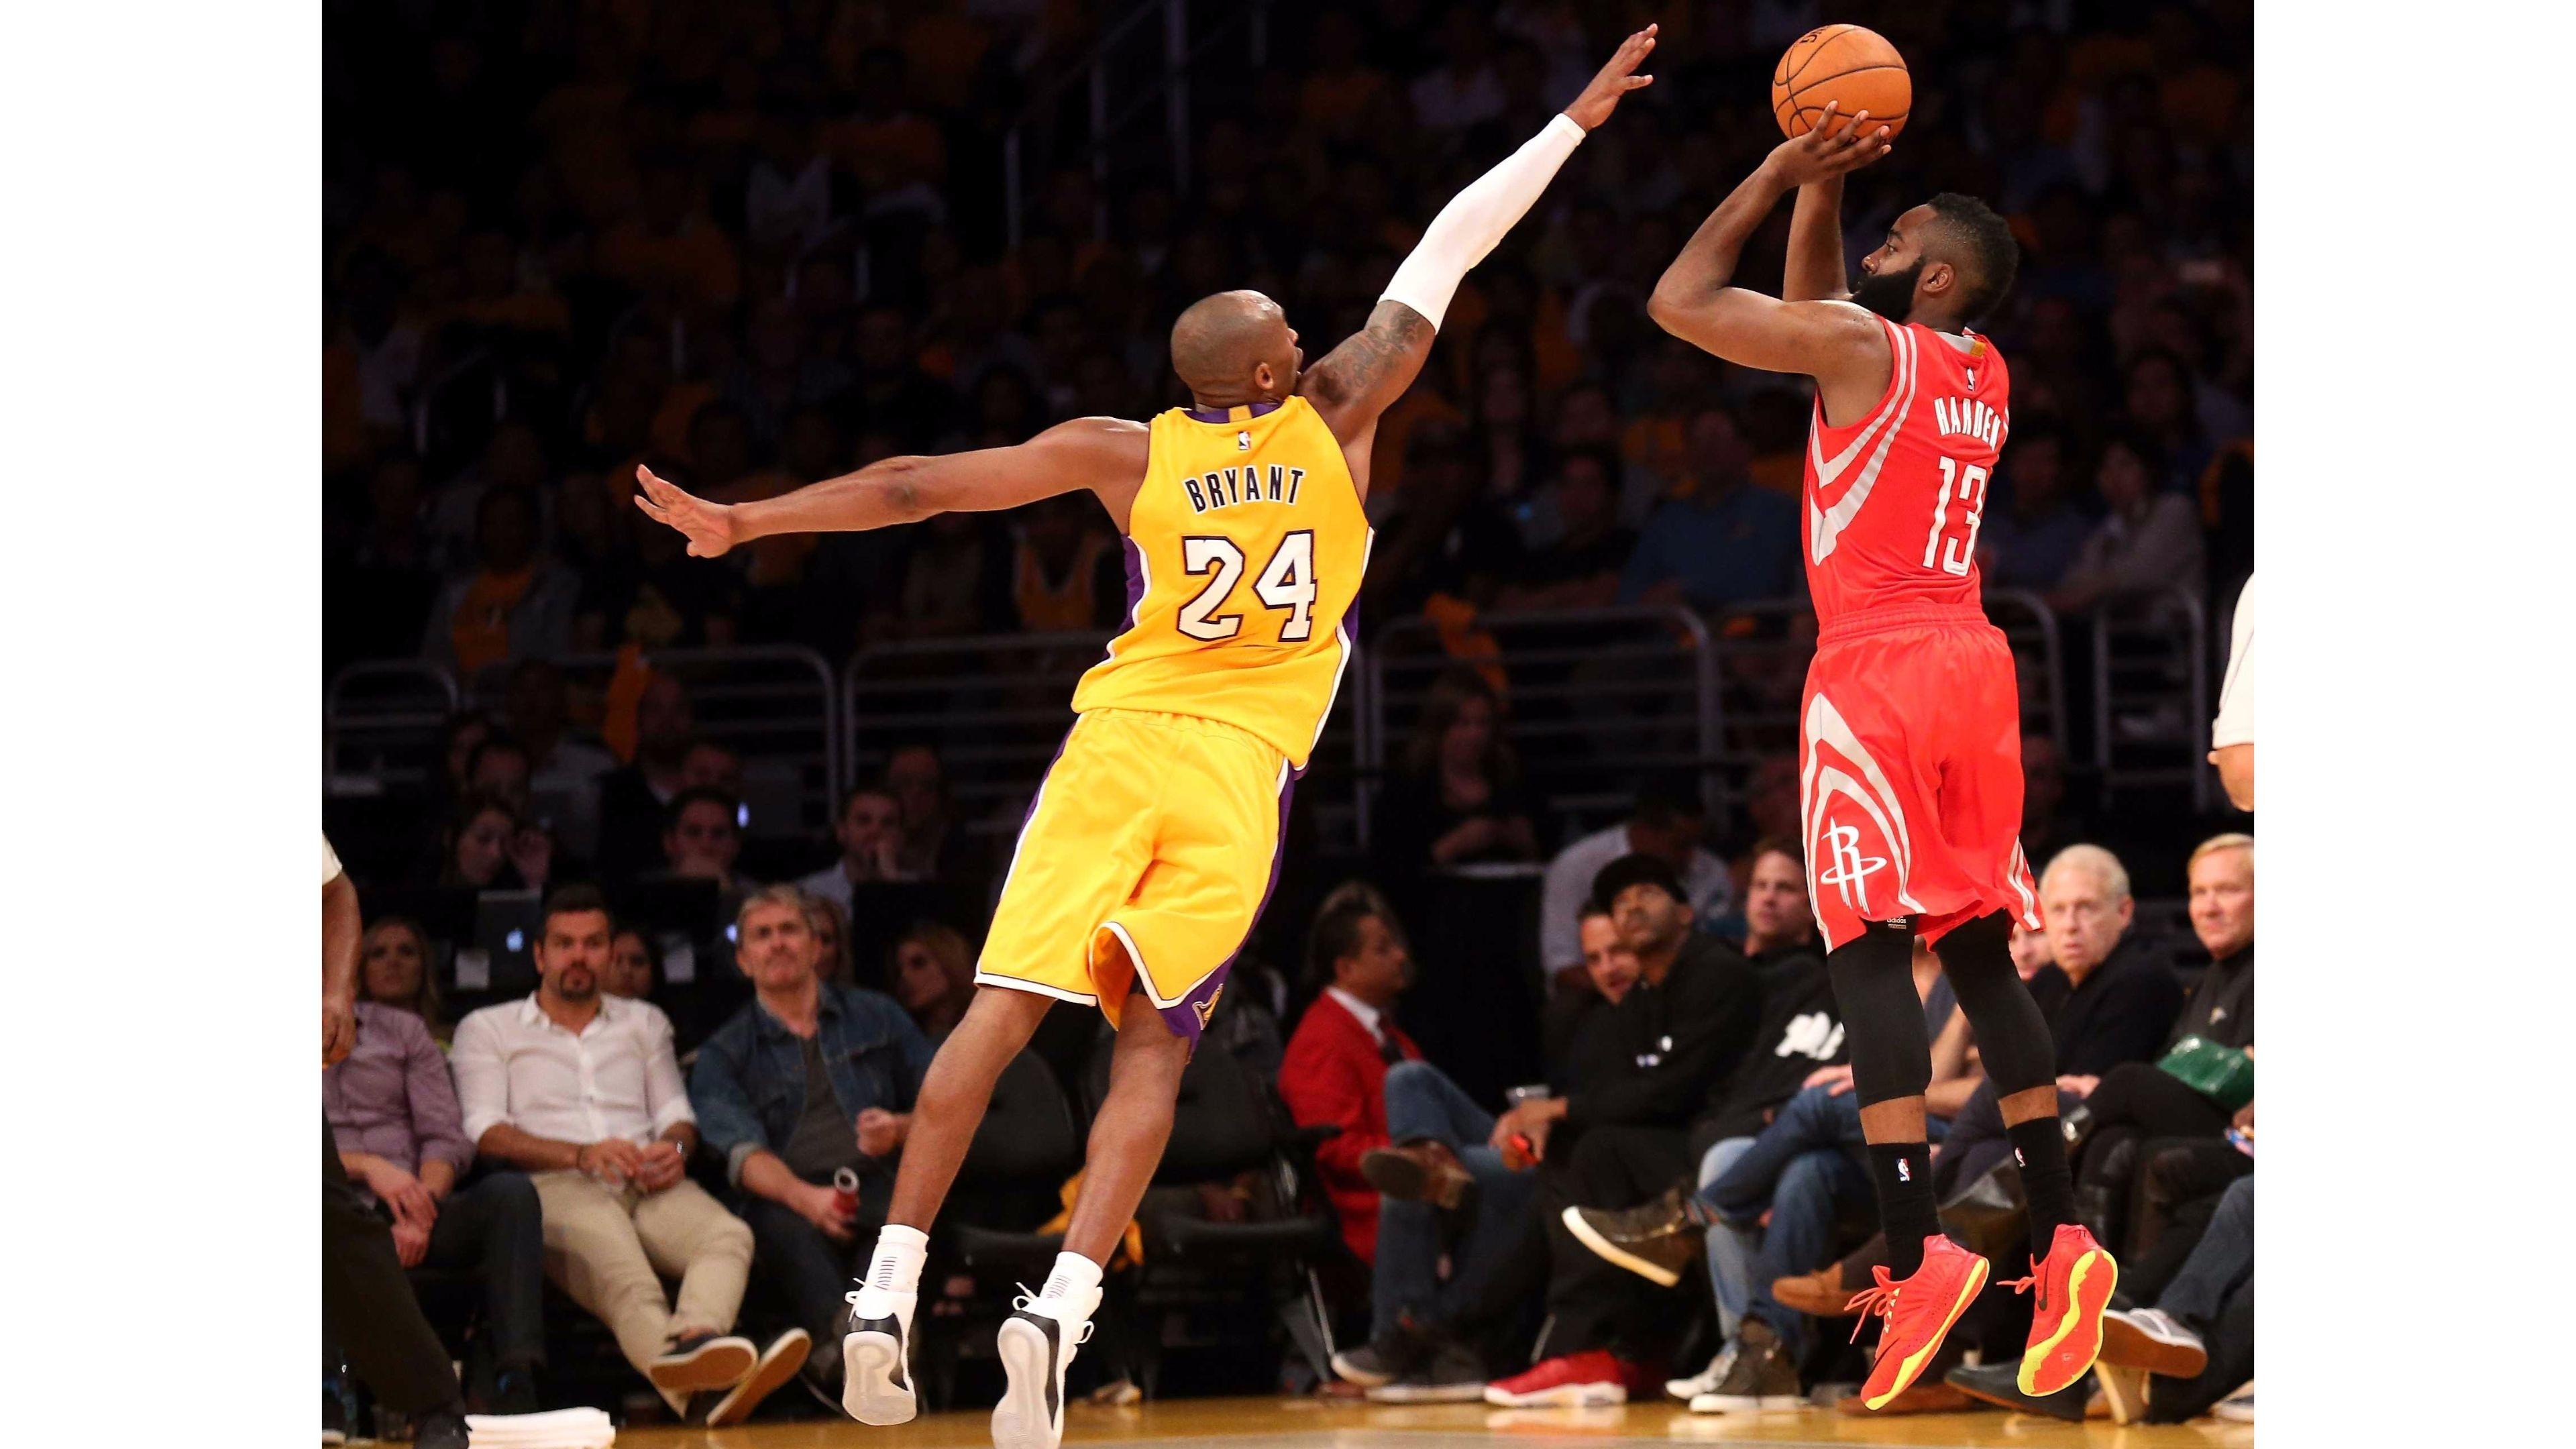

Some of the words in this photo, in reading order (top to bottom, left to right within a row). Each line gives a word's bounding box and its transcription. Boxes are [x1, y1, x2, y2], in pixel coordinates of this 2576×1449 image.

[1934, 396, 2001, 451] HARDEN
[1182, 464, 1305, 516] BRYANT
[1922, 455, 1986, 577] 13
[1176, 529, 1318, 642] 24
